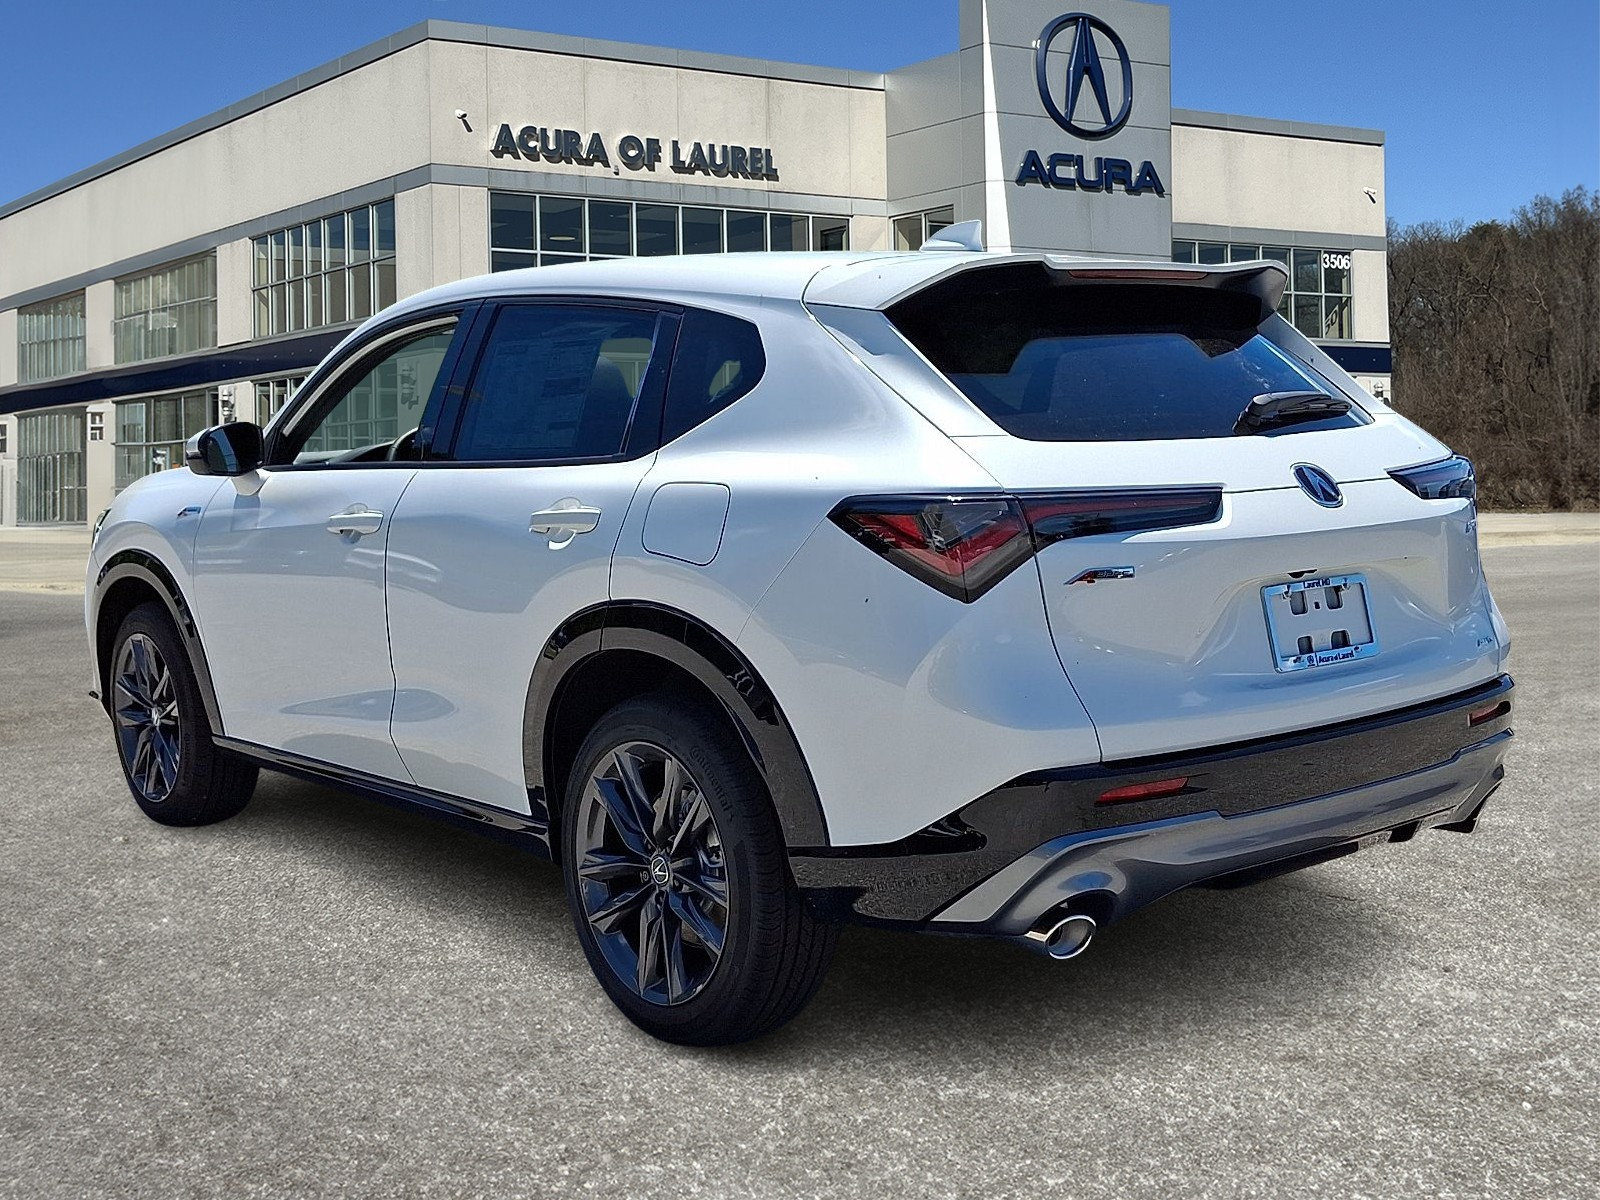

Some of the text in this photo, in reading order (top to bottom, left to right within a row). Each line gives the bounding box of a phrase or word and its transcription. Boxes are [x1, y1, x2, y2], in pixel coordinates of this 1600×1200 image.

[490, 124, 779, 181] ACURA OF LAUREL
[1015, 150, 1165, 198] ACURA
[1322, 254, 1350, 269] 3506
[1303, 579, 1320, 589] Laurel
[1339, 651, 1354, 659] Laurel
